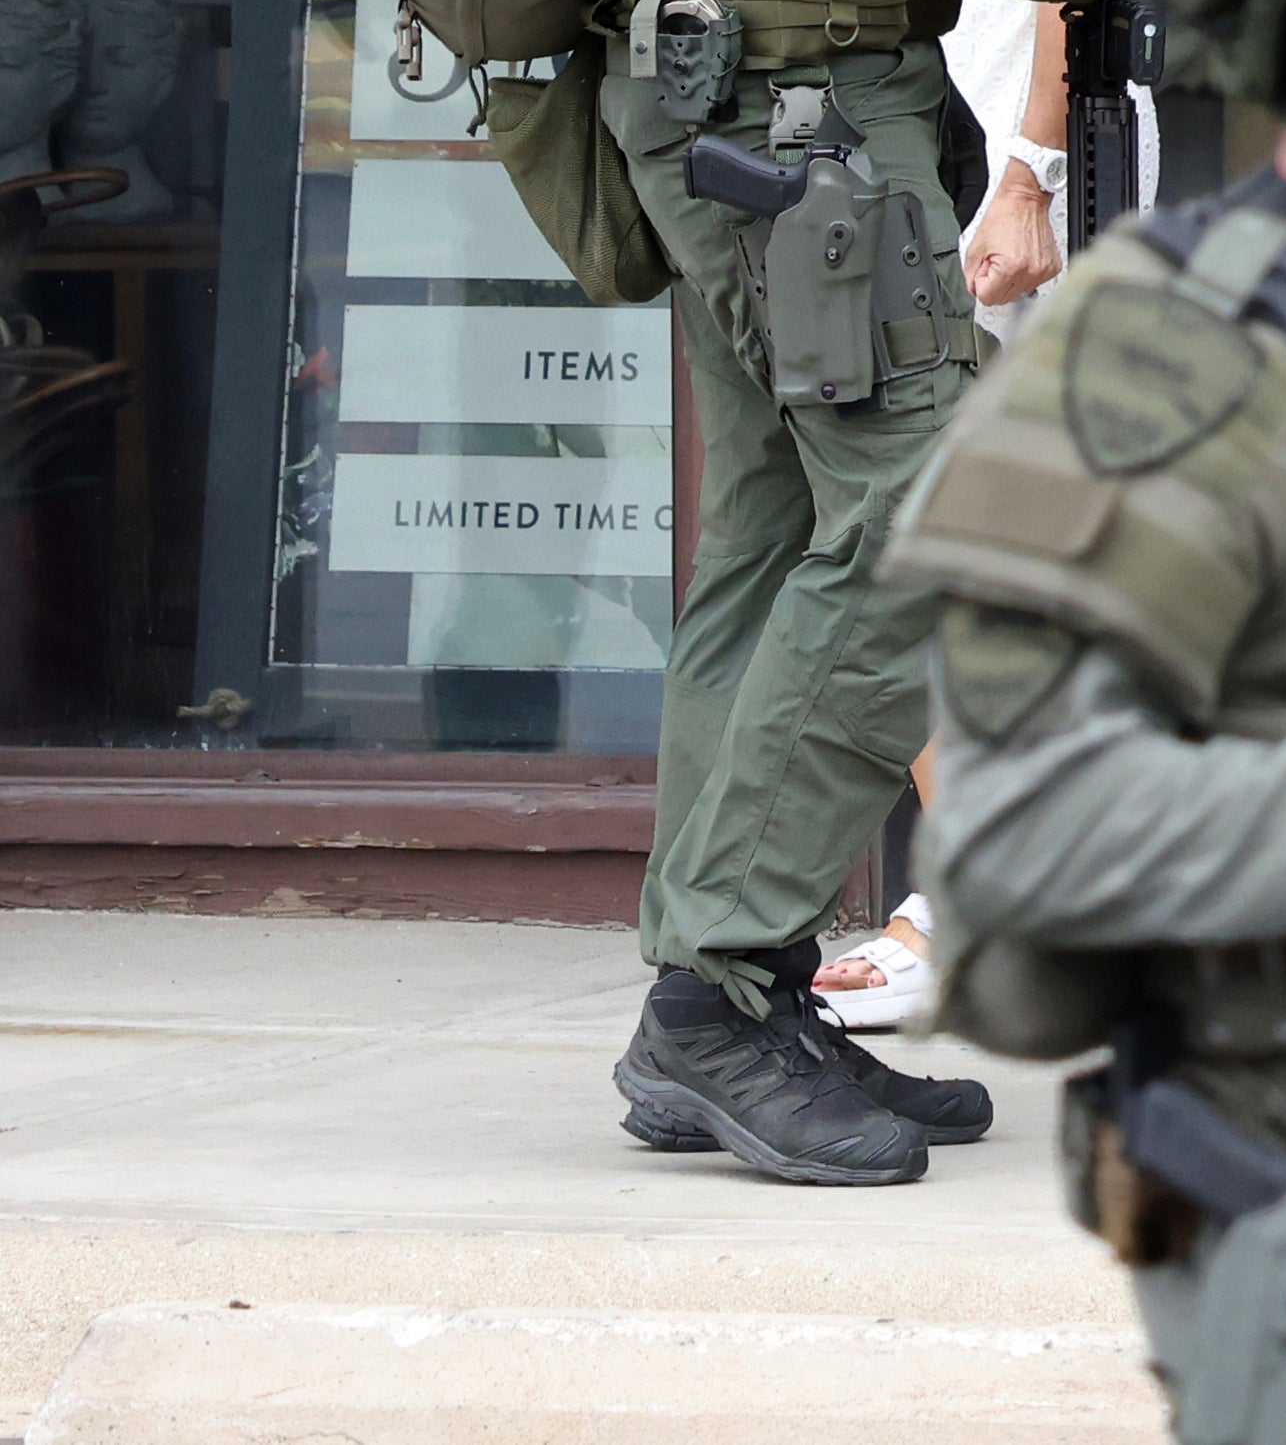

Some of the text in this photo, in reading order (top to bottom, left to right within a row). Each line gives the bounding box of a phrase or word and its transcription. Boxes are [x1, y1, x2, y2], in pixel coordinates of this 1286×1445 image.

[523, 351, 639, 382] ITEMS
[394, 500, 540, 530] LIMITED
[554, 502, 640, 531] TIME
